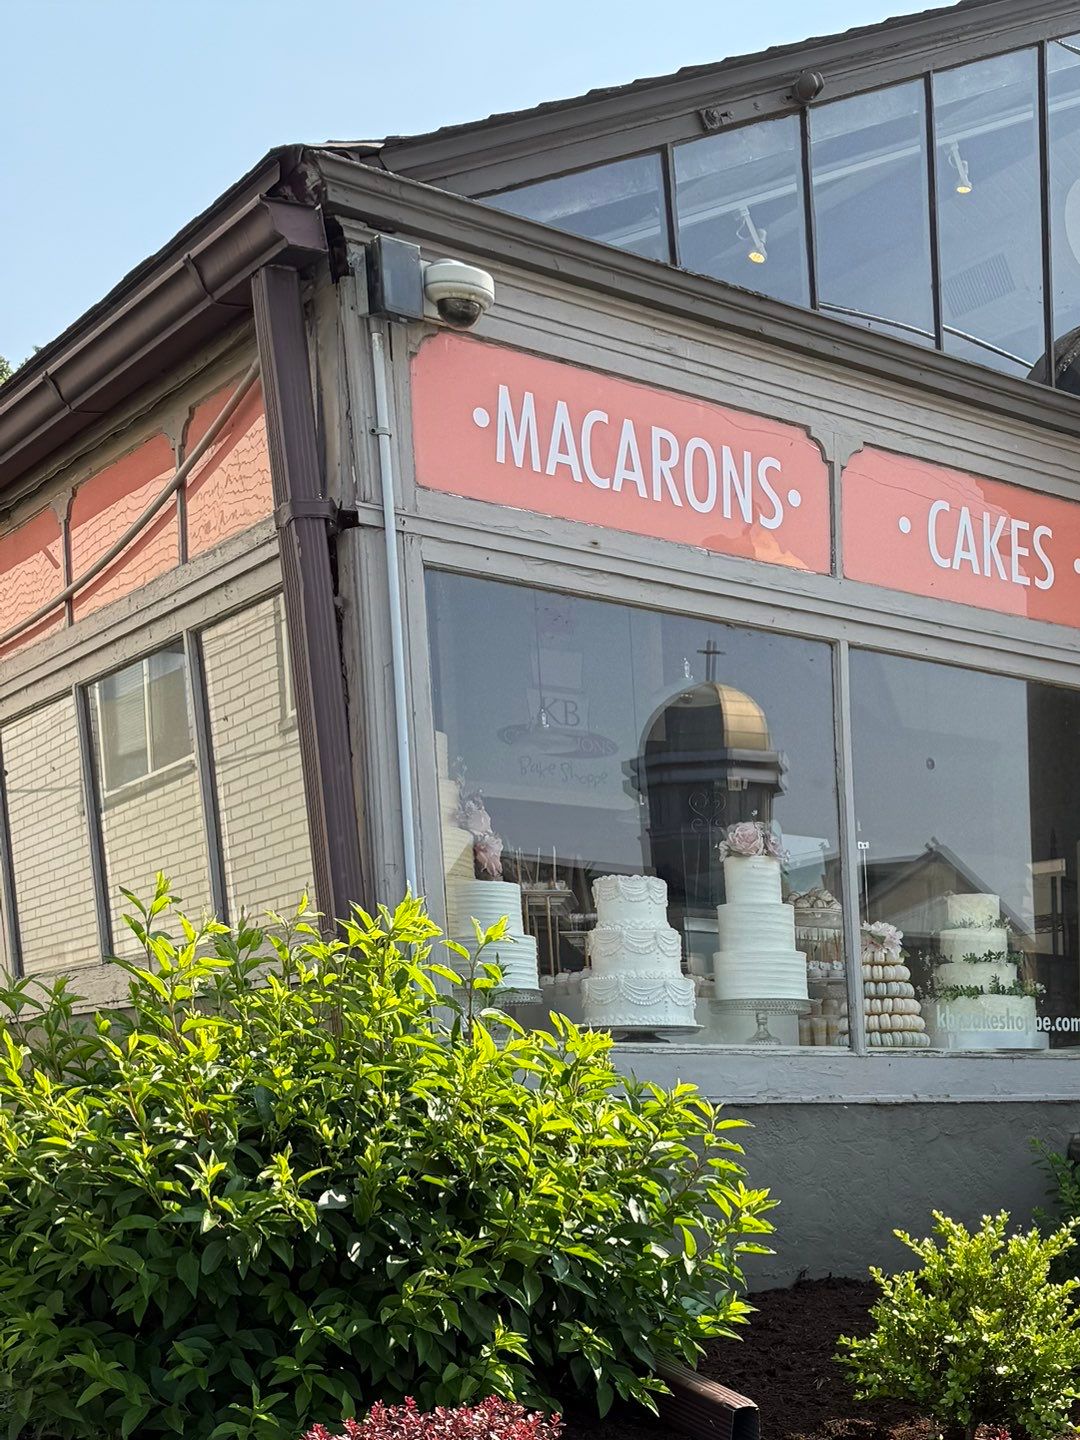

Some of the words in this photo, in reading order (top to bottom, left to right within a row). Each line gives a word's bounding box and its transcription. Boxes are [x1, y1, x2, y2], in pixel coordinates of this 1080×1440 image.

[496, 384, 784, 530] MACARONS
[927, 499, 1056, 590] CAKES
[540, 697, 581, 727] KB
